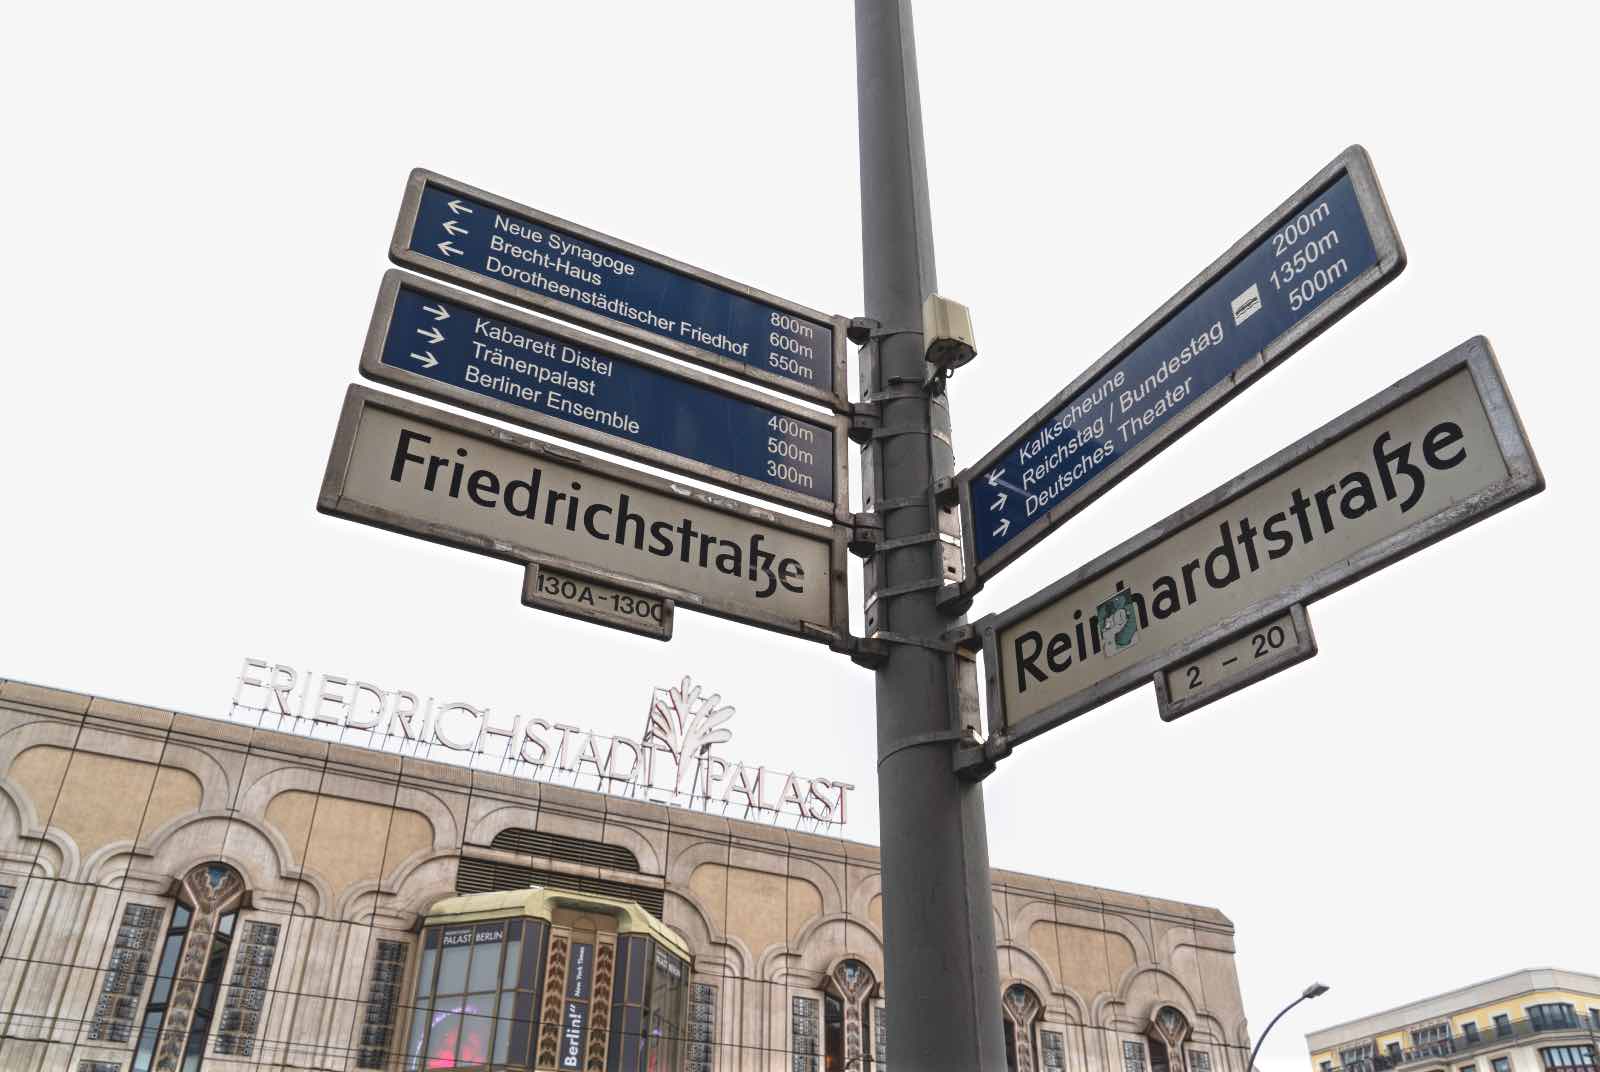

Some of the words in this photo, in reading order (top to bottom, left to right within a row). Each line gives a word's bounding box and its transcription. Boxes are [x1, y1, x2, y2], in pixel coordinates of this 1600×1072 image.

[494, 214, 543, 243] Neue
[548, 233, 635, 276] Synagoge
[1272, 201, 1330, 256] 200m
[490, 235, 602, 286] Brecht-Haus
[1269, 229, 1339, 290] 1350m
[1288, 257, 1348, 312] 500m
[486, 255, 676, 332] Dorotheenstädtischer
[680, 323, 749, 357] Friedhof
[770, 311, 813, 338] 800m
[472, 341, 596, 396] Tränenpalast
[474, 317, 556, 358] Kabarett
[561, 346, 613, 377] Distel
[768, 352, 813, 380] 550m
[769, 331, 813, 359] 600m
[465, 365, 542, 403] Berliner
[547, 391, 641, 434] Ensemble
[1019, 370, 1125, 465] Kalkscheune
[1022, 417, 1104, 490] Reichstag
[1119, 320, 1224, 414] Bundestag
[768, 415, 814, 442] 400m
[768, 438, 813, 465] 500m
[1025, 439, 1114, 517] Deutsches
[1117, 376, 1192, 443] Theater
[767, 460, 813, 488] 300m
[390, 428, 806, 599] Friedrichstraße
[1187, 666, 1202, 689] 2
[1252, 626, 1285, 659] 20
[704, 755, 855, 824] PALAST
[444, 934, 471, 945] PALAST
[476, 931, 503, 941] BERLIN
